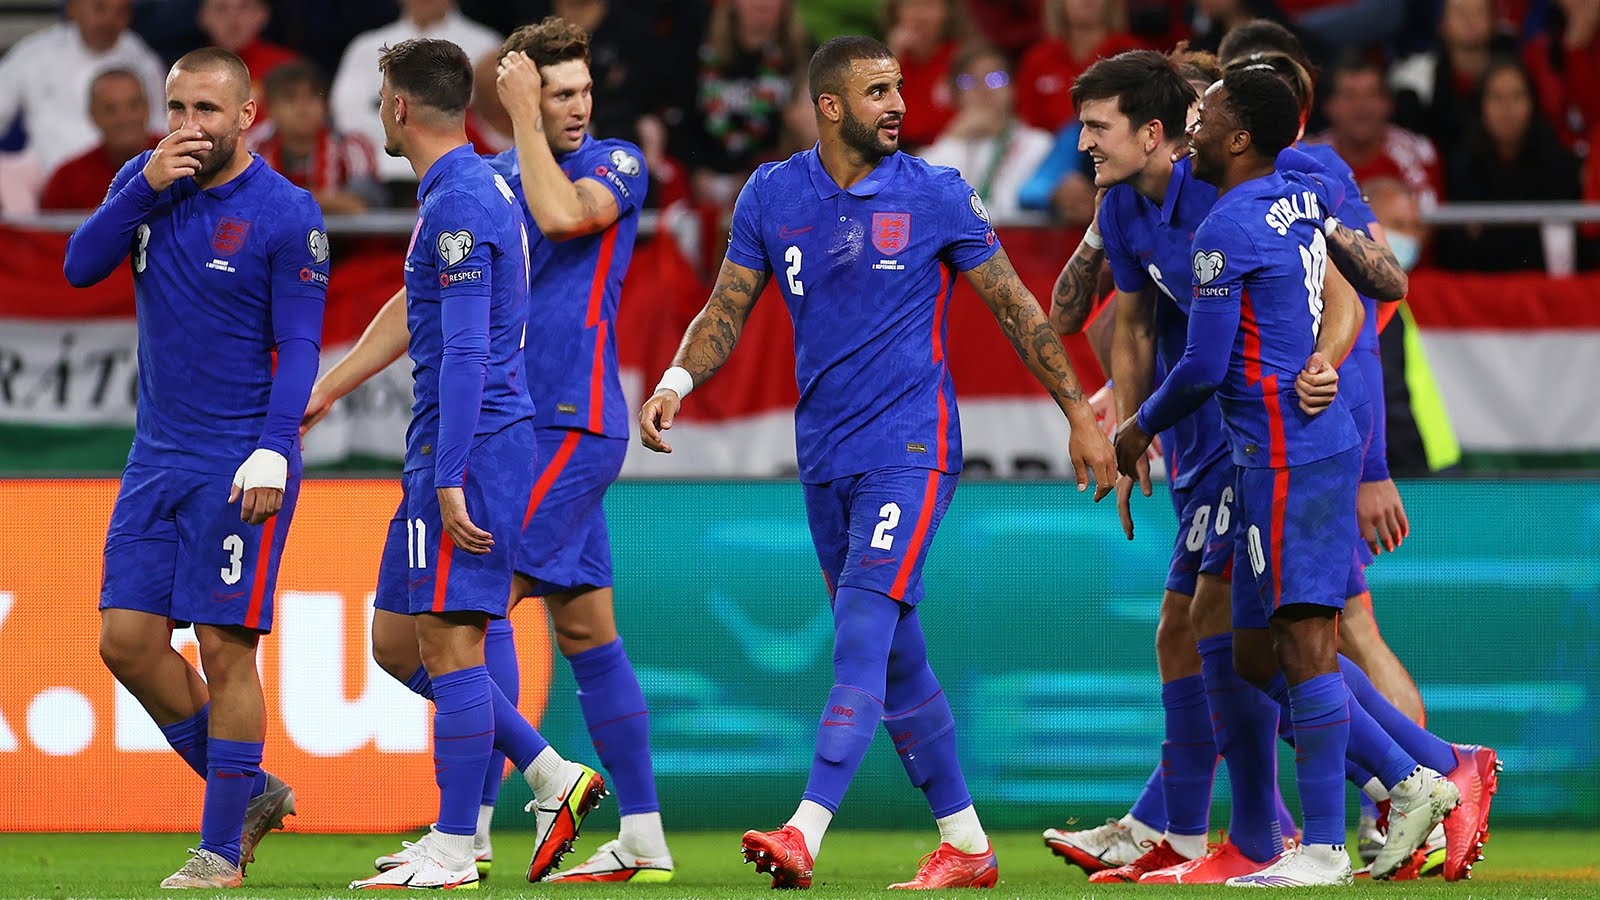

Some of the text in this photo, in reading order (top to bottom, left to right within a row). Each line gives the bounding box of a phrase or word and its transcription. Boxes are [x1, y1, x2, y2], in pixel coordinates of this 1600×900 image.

[135, 223, 151, 273] 3
[784, 245, 804, 296] 2
[449, 270, 483, 284] RESPECT
[1199, 287, 1230, 297] RESPECT
[870, 502, 902, 551] 2
[1185, 505, 1211, 552] 8
[1215, 486, 1234, 535] 6
[221, 533, 244, 585] 3
[407, 518, 427, 569] 11
[1247, 524, 1266, 578] 0
